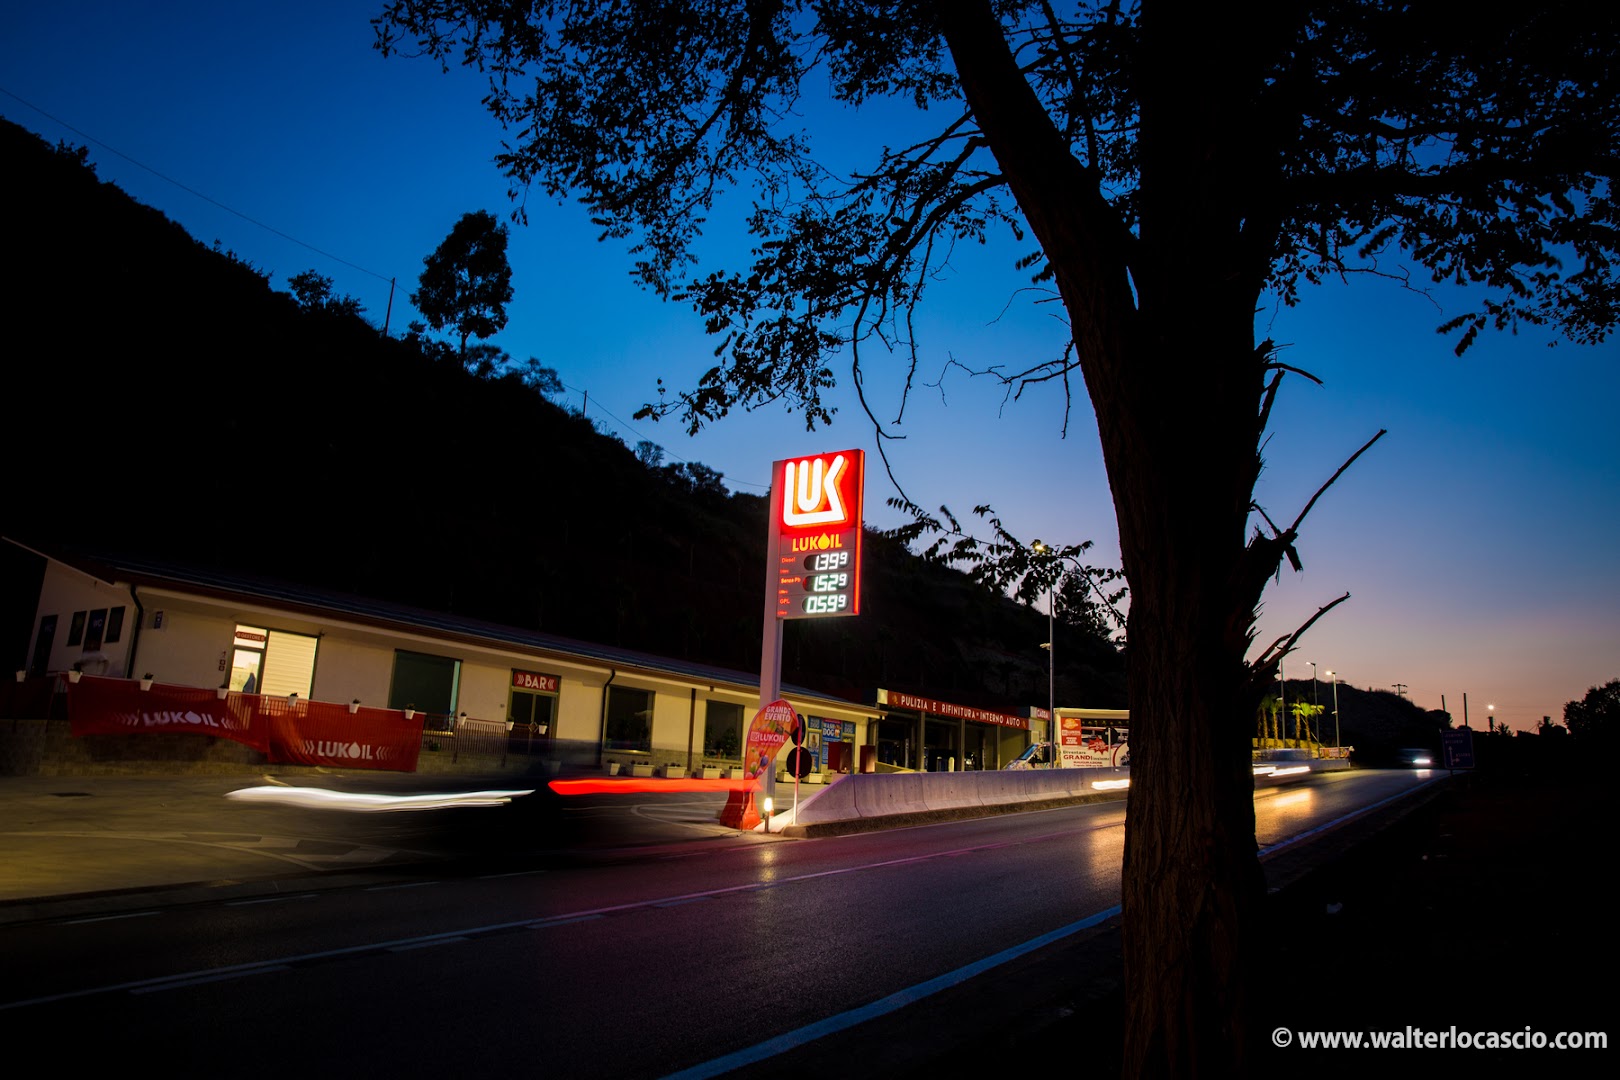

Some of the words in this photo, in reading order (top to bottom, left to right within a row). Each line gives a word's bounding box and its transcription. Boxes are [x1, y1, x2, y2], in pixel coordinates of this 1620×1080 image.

[783, 454, 848, 526] LUK
[792, 533, 843, 552] LUKOIL
[524, 674, 547, 690] BAR
[142, 710, 219, 728] LUKOIL
[764, 712, 791, 722] EVENTO
[901, 695, 928, 710] PULIZIA
[932, 702, 937, 712] E
[941, 703, 976, 719] RIFINITURA
[979, 711, 1004, 724] INTERNO
[1005, 716, 1021, 727] AUTO
[759, 733, 785, 743] LUKOIL
[317, 740, 373, 760] LUKOIL
